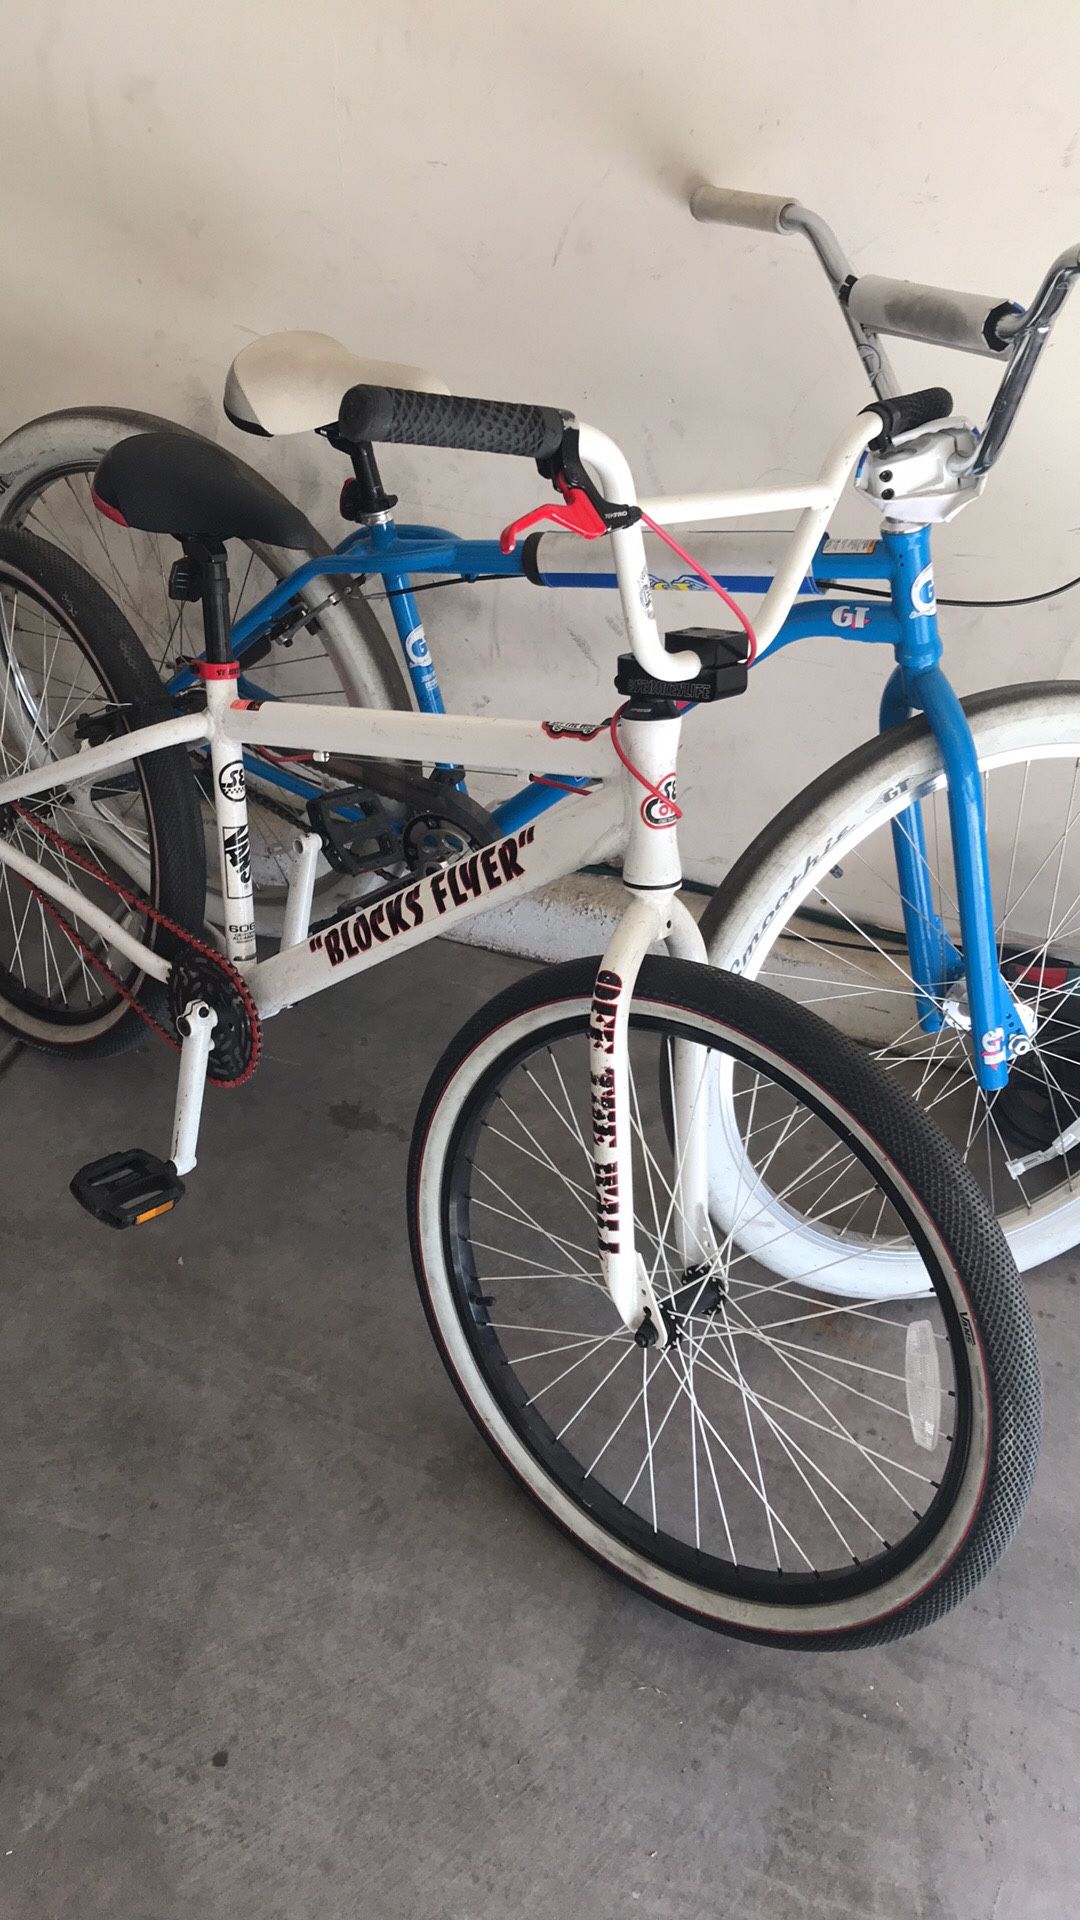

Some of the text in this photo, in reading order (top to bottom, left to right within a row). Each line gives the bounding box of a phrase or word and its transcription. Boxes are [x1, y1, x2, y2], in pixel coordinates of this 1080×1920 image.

[832, 605, 870, 630] GT
[882, 777, 911, 803] GT
[981, 1026, 1007, 1068] GT
